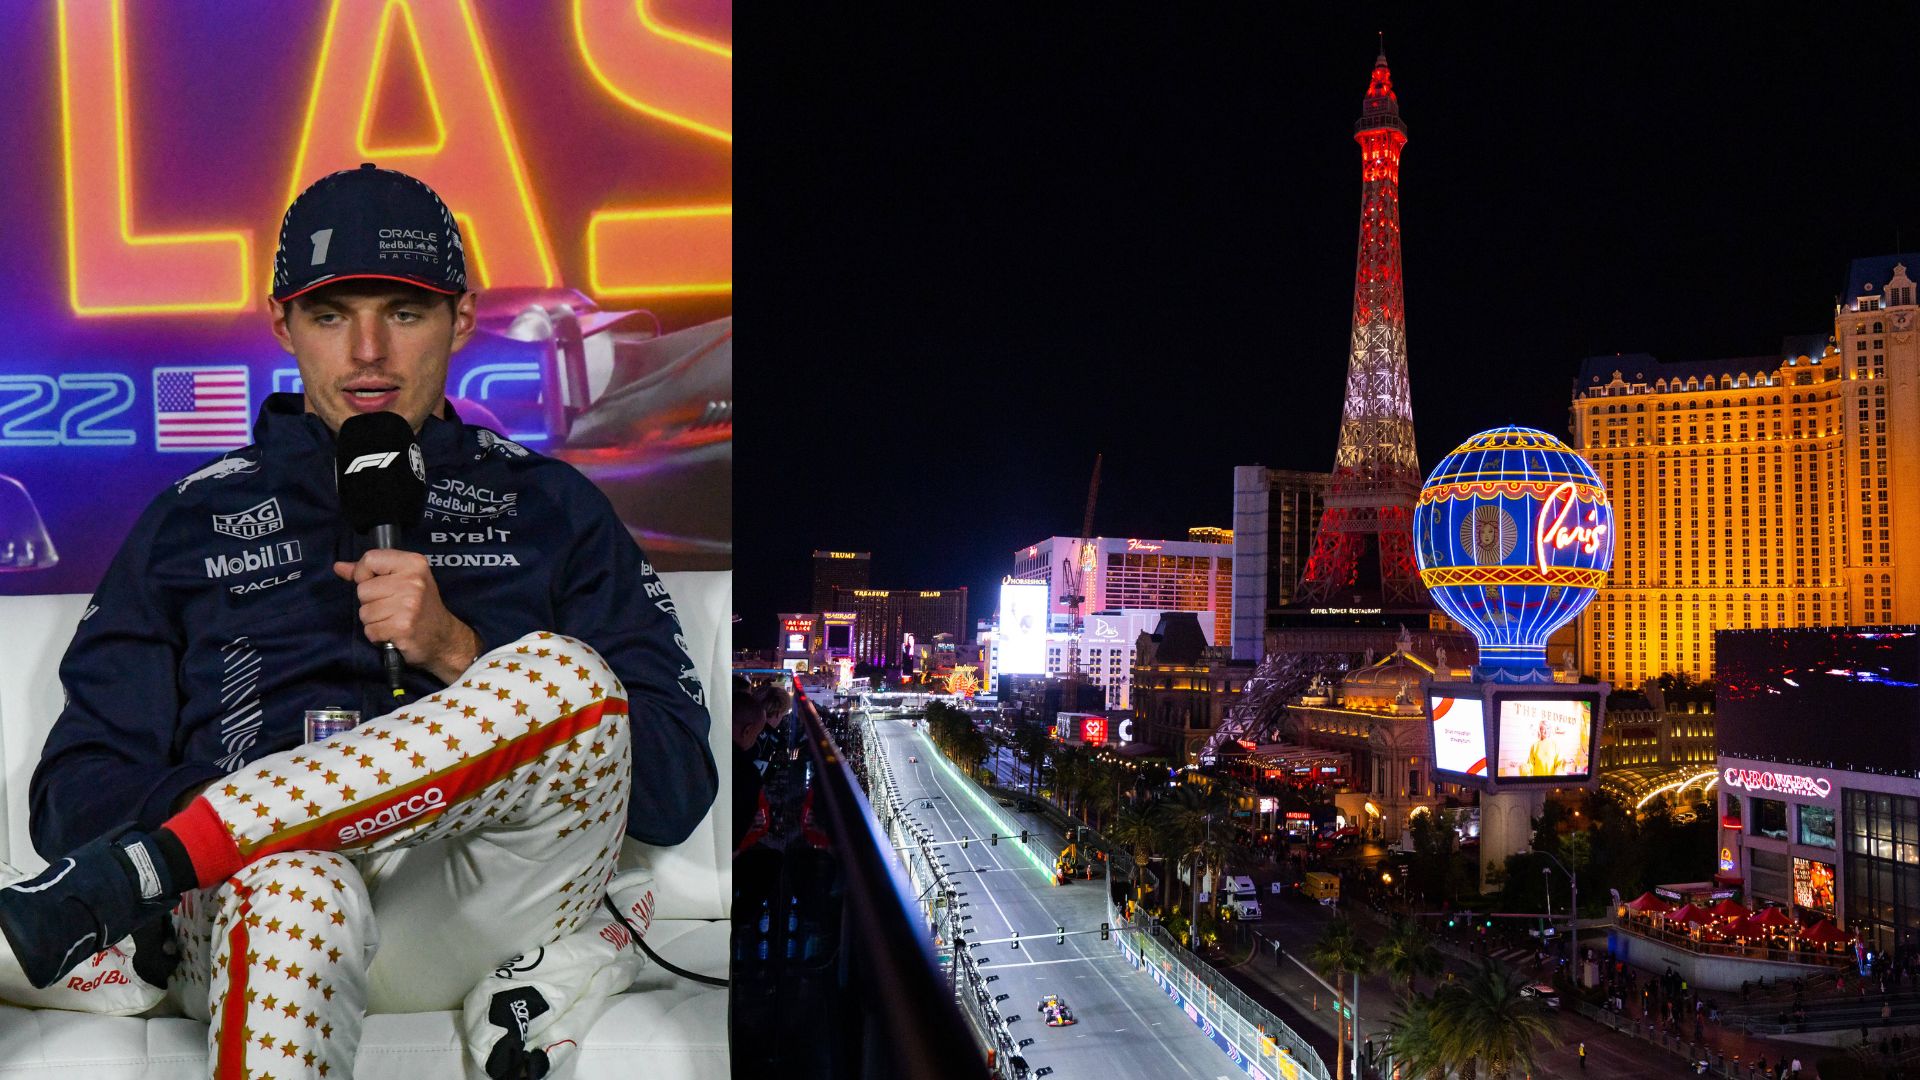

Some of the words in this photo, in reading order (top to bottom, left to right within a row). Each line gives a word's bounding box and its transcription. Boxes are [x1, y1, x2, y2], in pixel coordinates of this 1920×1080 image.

[379, 229, 437, 242] ORACLE
[310, 228, 333, 266] 1
[379, 241, 398, 250] Red
[398, 241, 414, 250] Bull
[379, 253, 438, 264] RACING
[219, 504, 275, 525] TAG
[451, 498, 474, 514] Bull
[217, 522, 279, 538] HEUER
[431, 526, 511, 543] BYBIT
[1537, 481, 1607, 575] Paris
[1127, 538, 1162, 552] Flamingo
[204, 545, 276, 578] Mobil
[229, 570, 302, 595] RACLE
[1724, 767, 1775, 792] CABO
[338, 787, 446, 843] sparco
